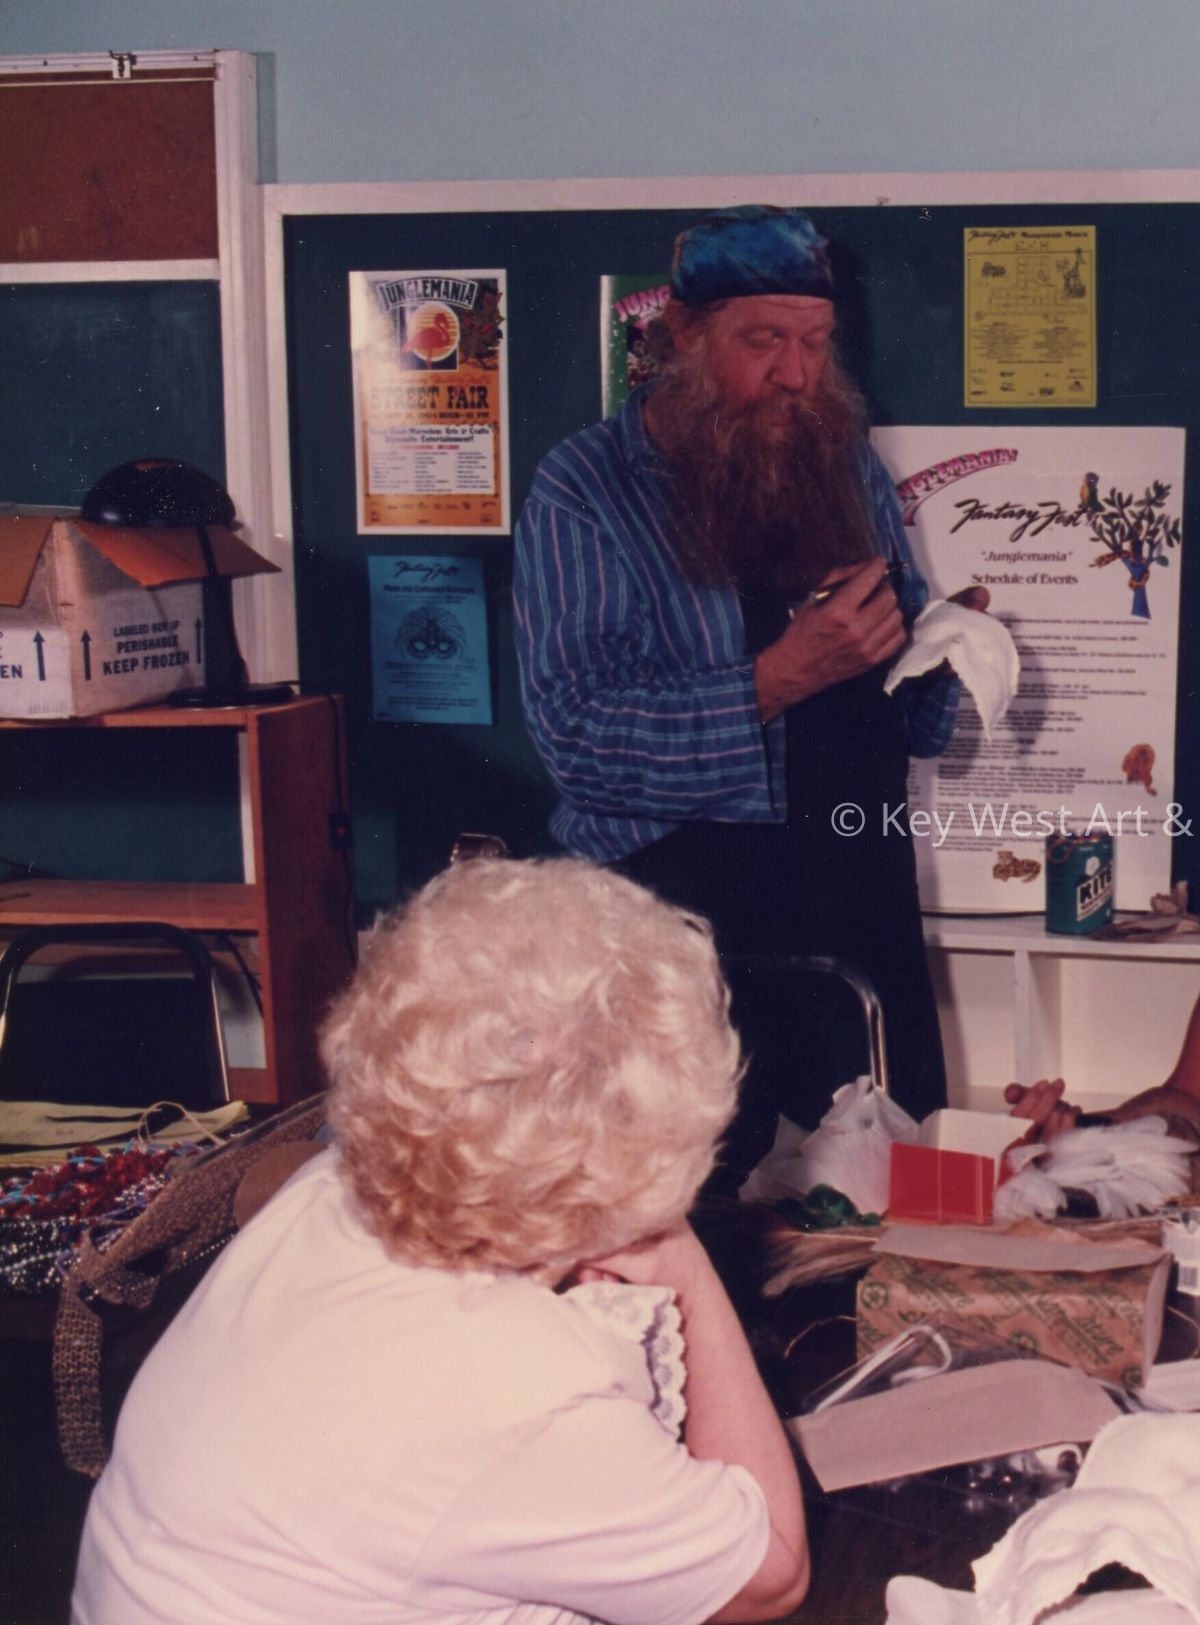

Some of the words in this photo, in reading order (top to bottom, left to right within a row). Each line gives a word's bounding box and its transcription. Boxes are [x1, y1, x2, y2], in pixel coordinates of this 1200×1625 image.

[380, 279, 475, 308] JUNGLEMANIA
[371, 386, 439, 409] STREET
[447, 386, 489, 409] FAIR
[950, 499, 1042, 542] Fantasy
[972, 573, 1026, 584] Schedule
[1028, 573, 1038, 584] of
[1040, 573, 1079, 585] Events
[117, 635, 179, 654] PERISHABLE
[103, 656, 138, 676] KEEP
[143, 651, 189, 670] FROZEN
